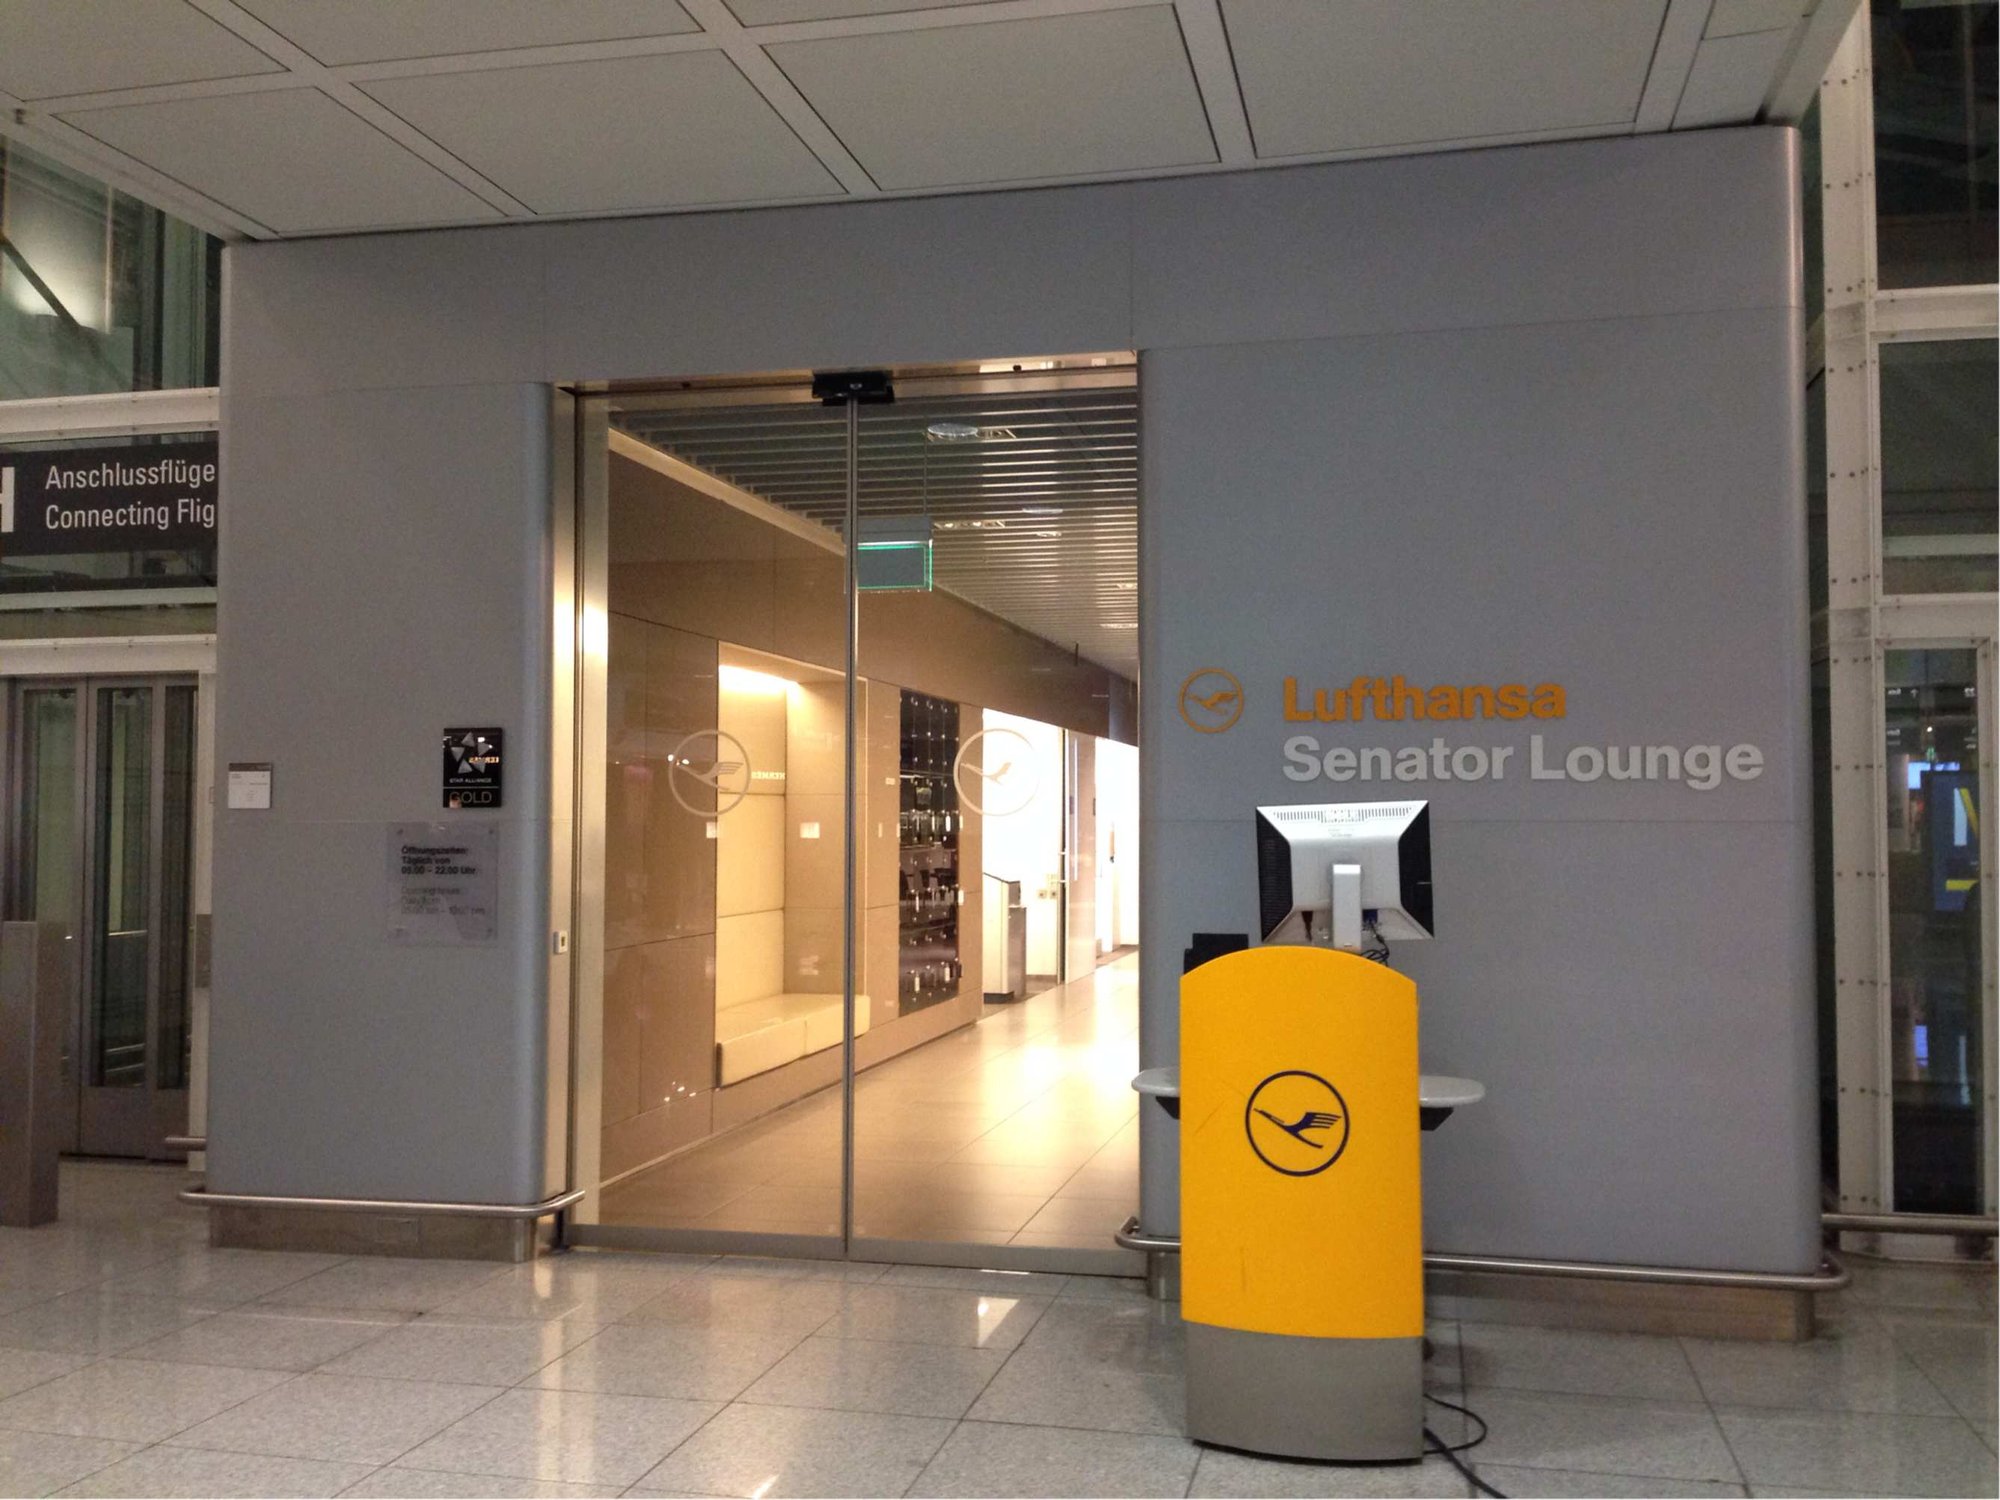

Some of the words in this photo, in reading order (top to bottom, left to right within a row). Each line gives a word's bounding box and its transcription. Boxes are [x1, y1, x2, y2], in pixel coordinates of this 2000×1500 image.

[45, 459, 216, 490] Anschlussflüge
[46, 500, 170, 530] Connecting
[177, 498, 216, 528] Flig
[1282, 675, 1567, 723] Lufthansa
[1281, 735, 1514, 783] Senator
[1529, 734, 1765, 790] Lounge
[449, 791, 492, 803] GOLD
